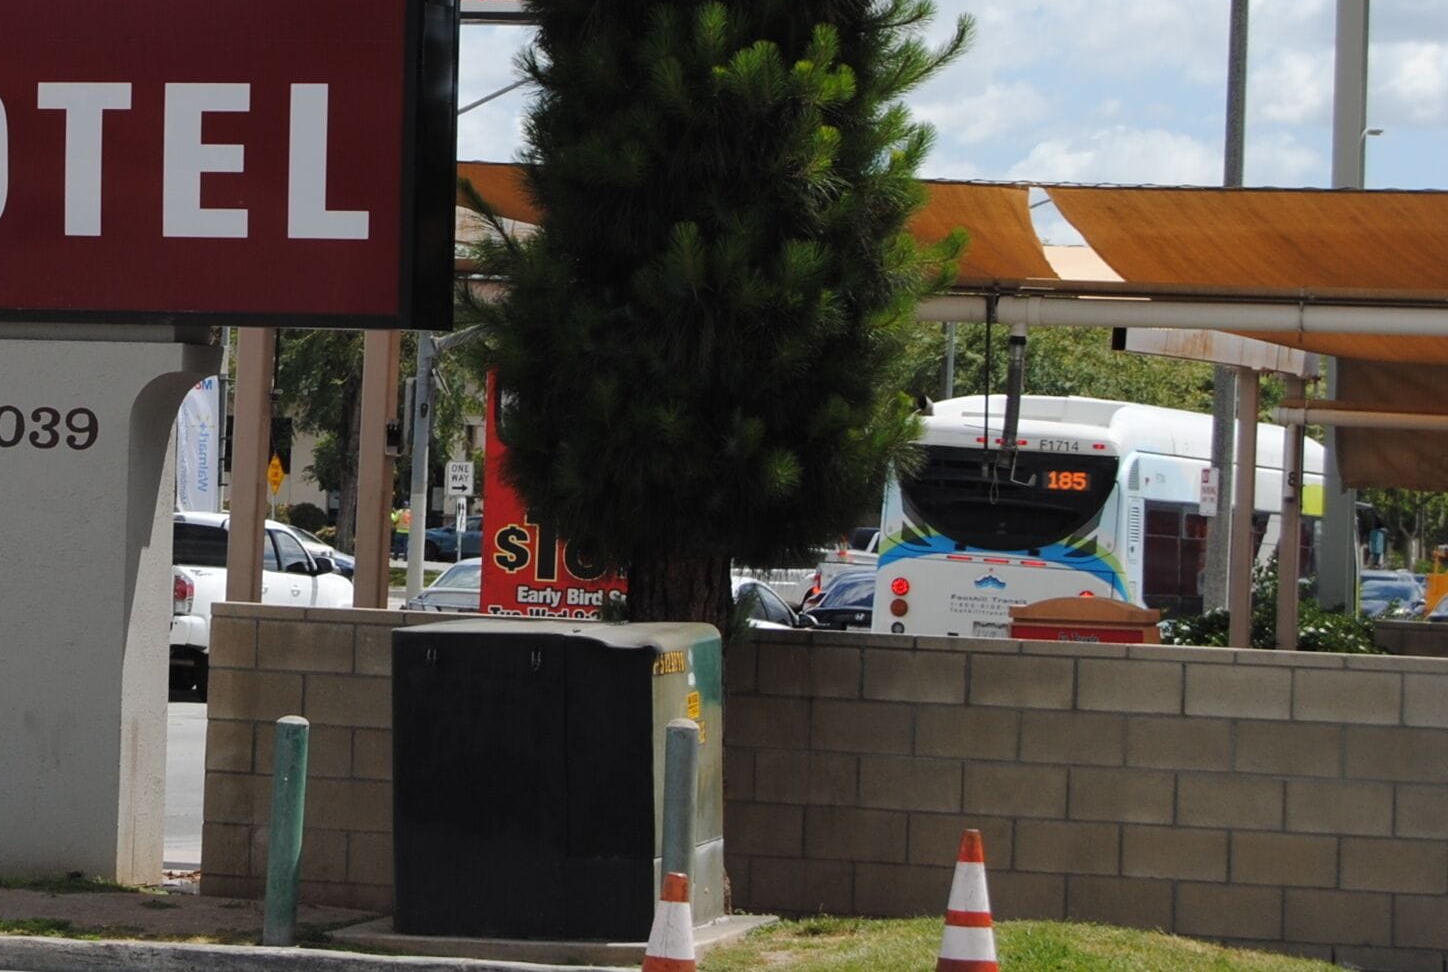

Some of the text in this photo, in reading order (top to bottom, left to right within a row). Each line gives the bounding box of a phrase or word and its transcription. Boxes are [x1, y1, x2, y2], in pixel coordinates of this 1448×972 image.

[1039, 439, 1080, 452] F1714
[451, 463, 470, 473] ONE
[451, 474, 470, 482] WAY
[1047, 470, 1088, 491] 185
[516, 585, 562, 608] Early
[566, 587, 604, 606] Bird
